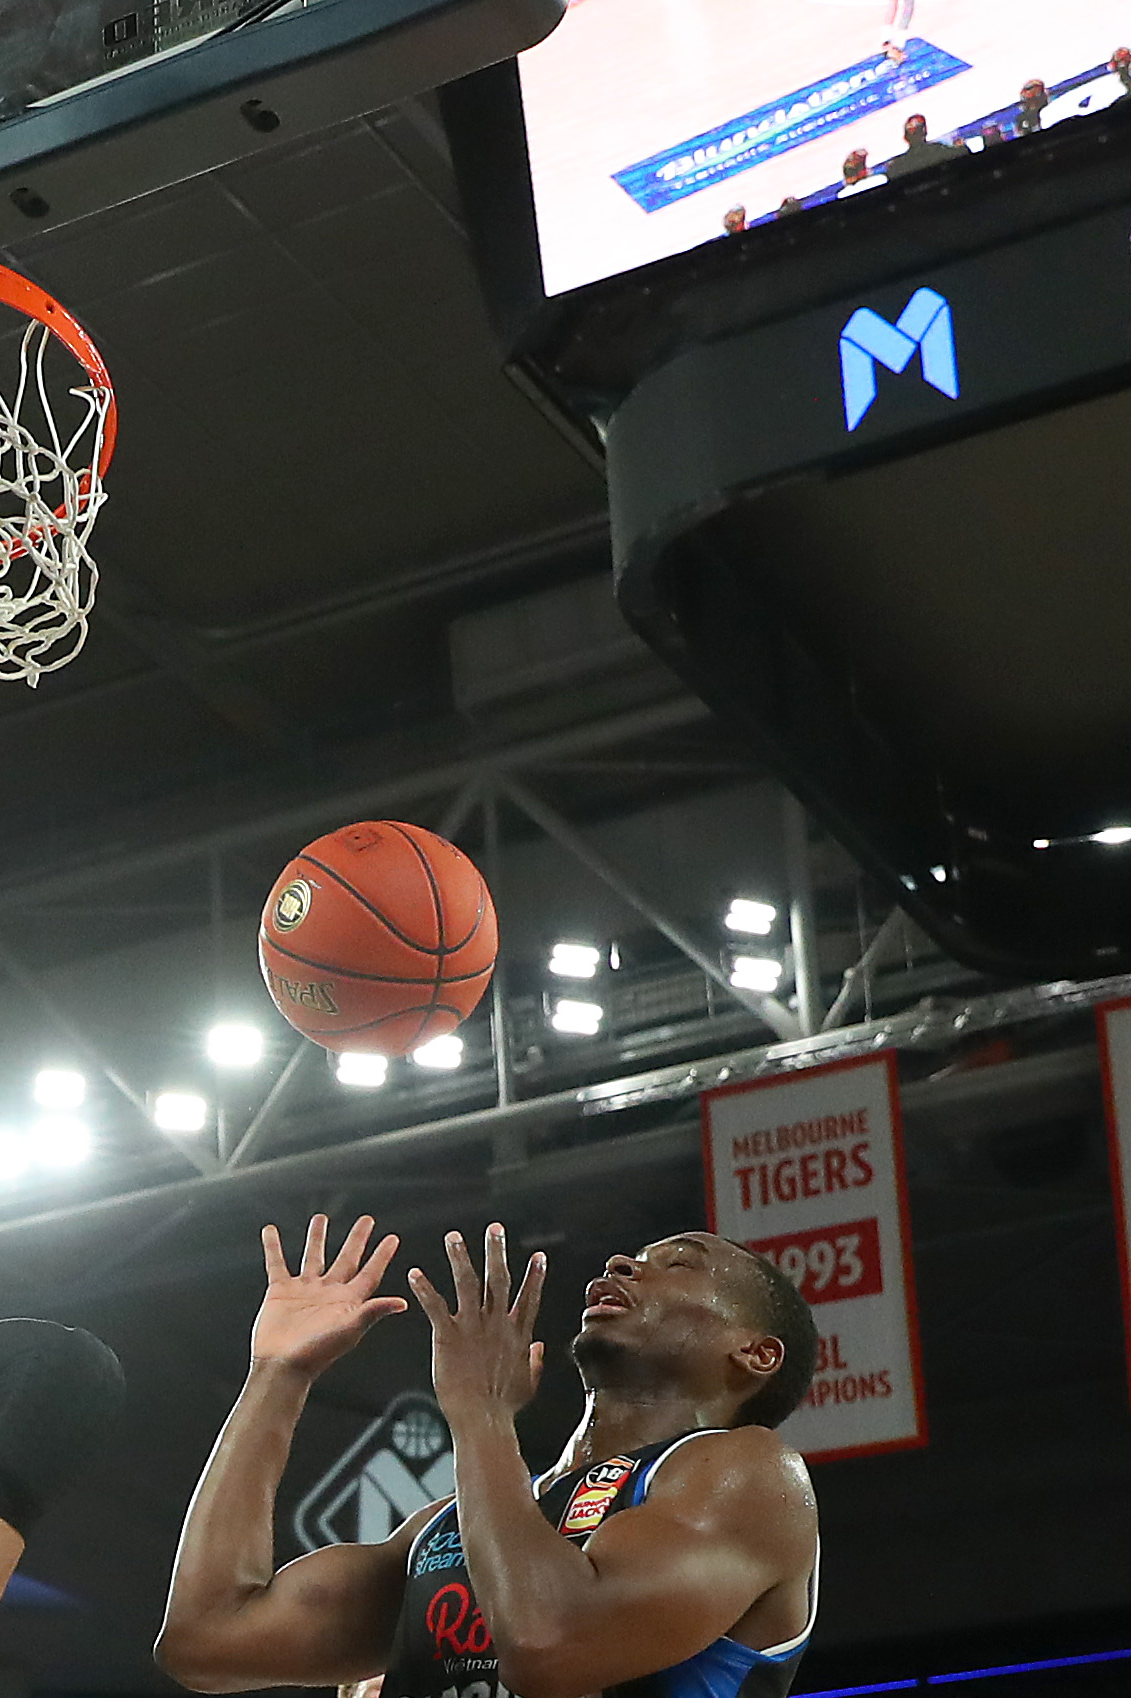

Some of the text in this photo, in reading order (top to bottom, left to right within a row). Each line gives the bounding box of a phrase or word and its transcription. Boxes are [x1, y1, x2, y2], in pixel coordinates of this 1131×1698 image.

[732, 1107, 870, 1162] MELBOURNE
[733, 1142, 875, 1211] TIGERS
[764, 1233, 865, 1292] 993
